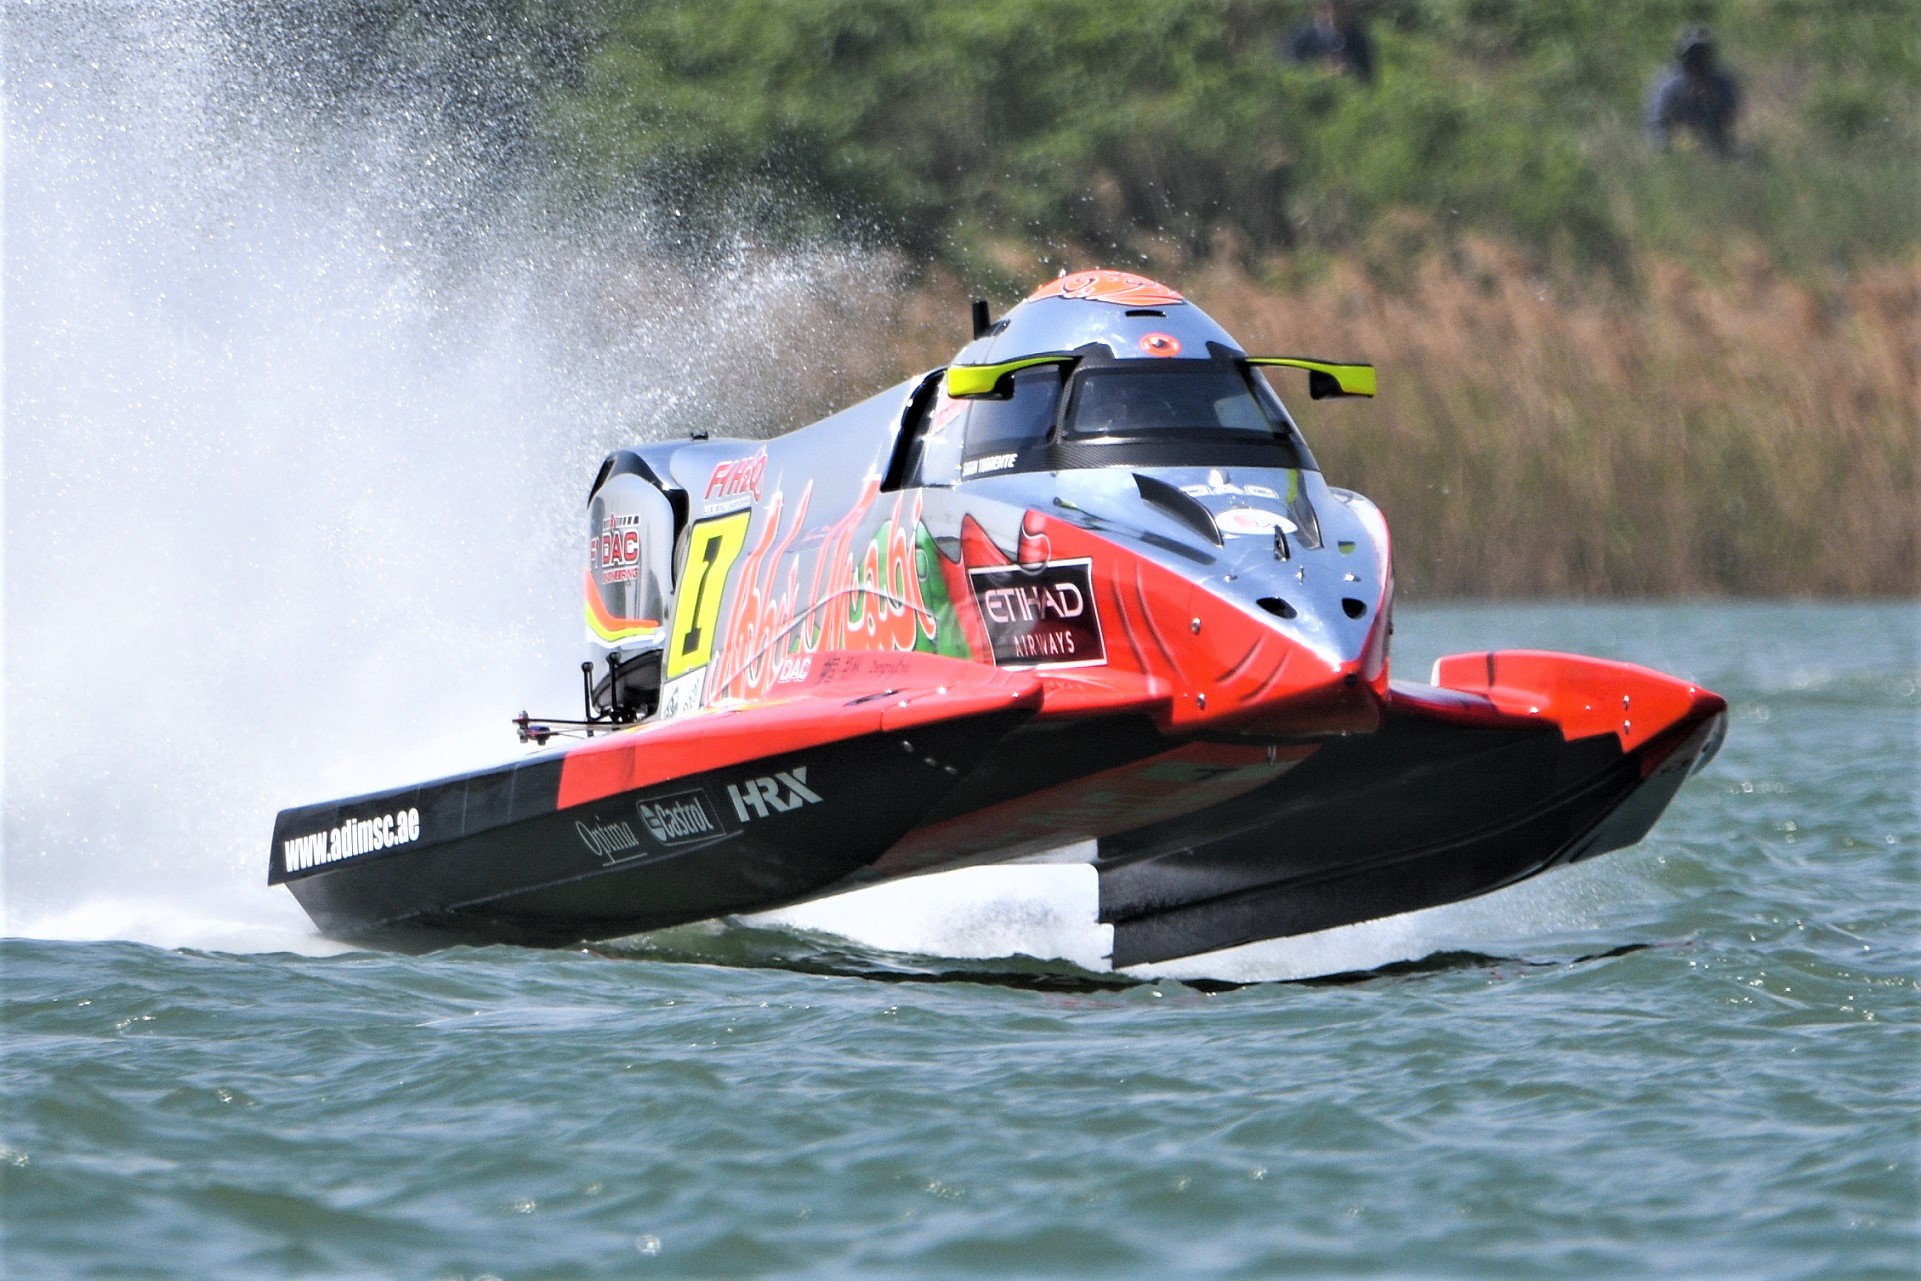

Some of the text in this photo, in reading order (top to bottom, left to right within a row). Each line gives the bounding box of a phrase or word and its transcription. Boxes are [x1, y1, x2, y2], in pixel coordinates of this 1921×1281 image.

[602, 529, 639, 567] DAC
[984, 582, 1084, 623] ETIHAD
[1013, 630, 1075, 658] AIRWAYS
[778, 656, 813, 684] DAC
[727, 766, 824, 823] HRX
[654, 797, 715, 839] Castrol
[284, 807, 421, 873] www.adimsc.ae
[576, 815, 641, 864] Optima
